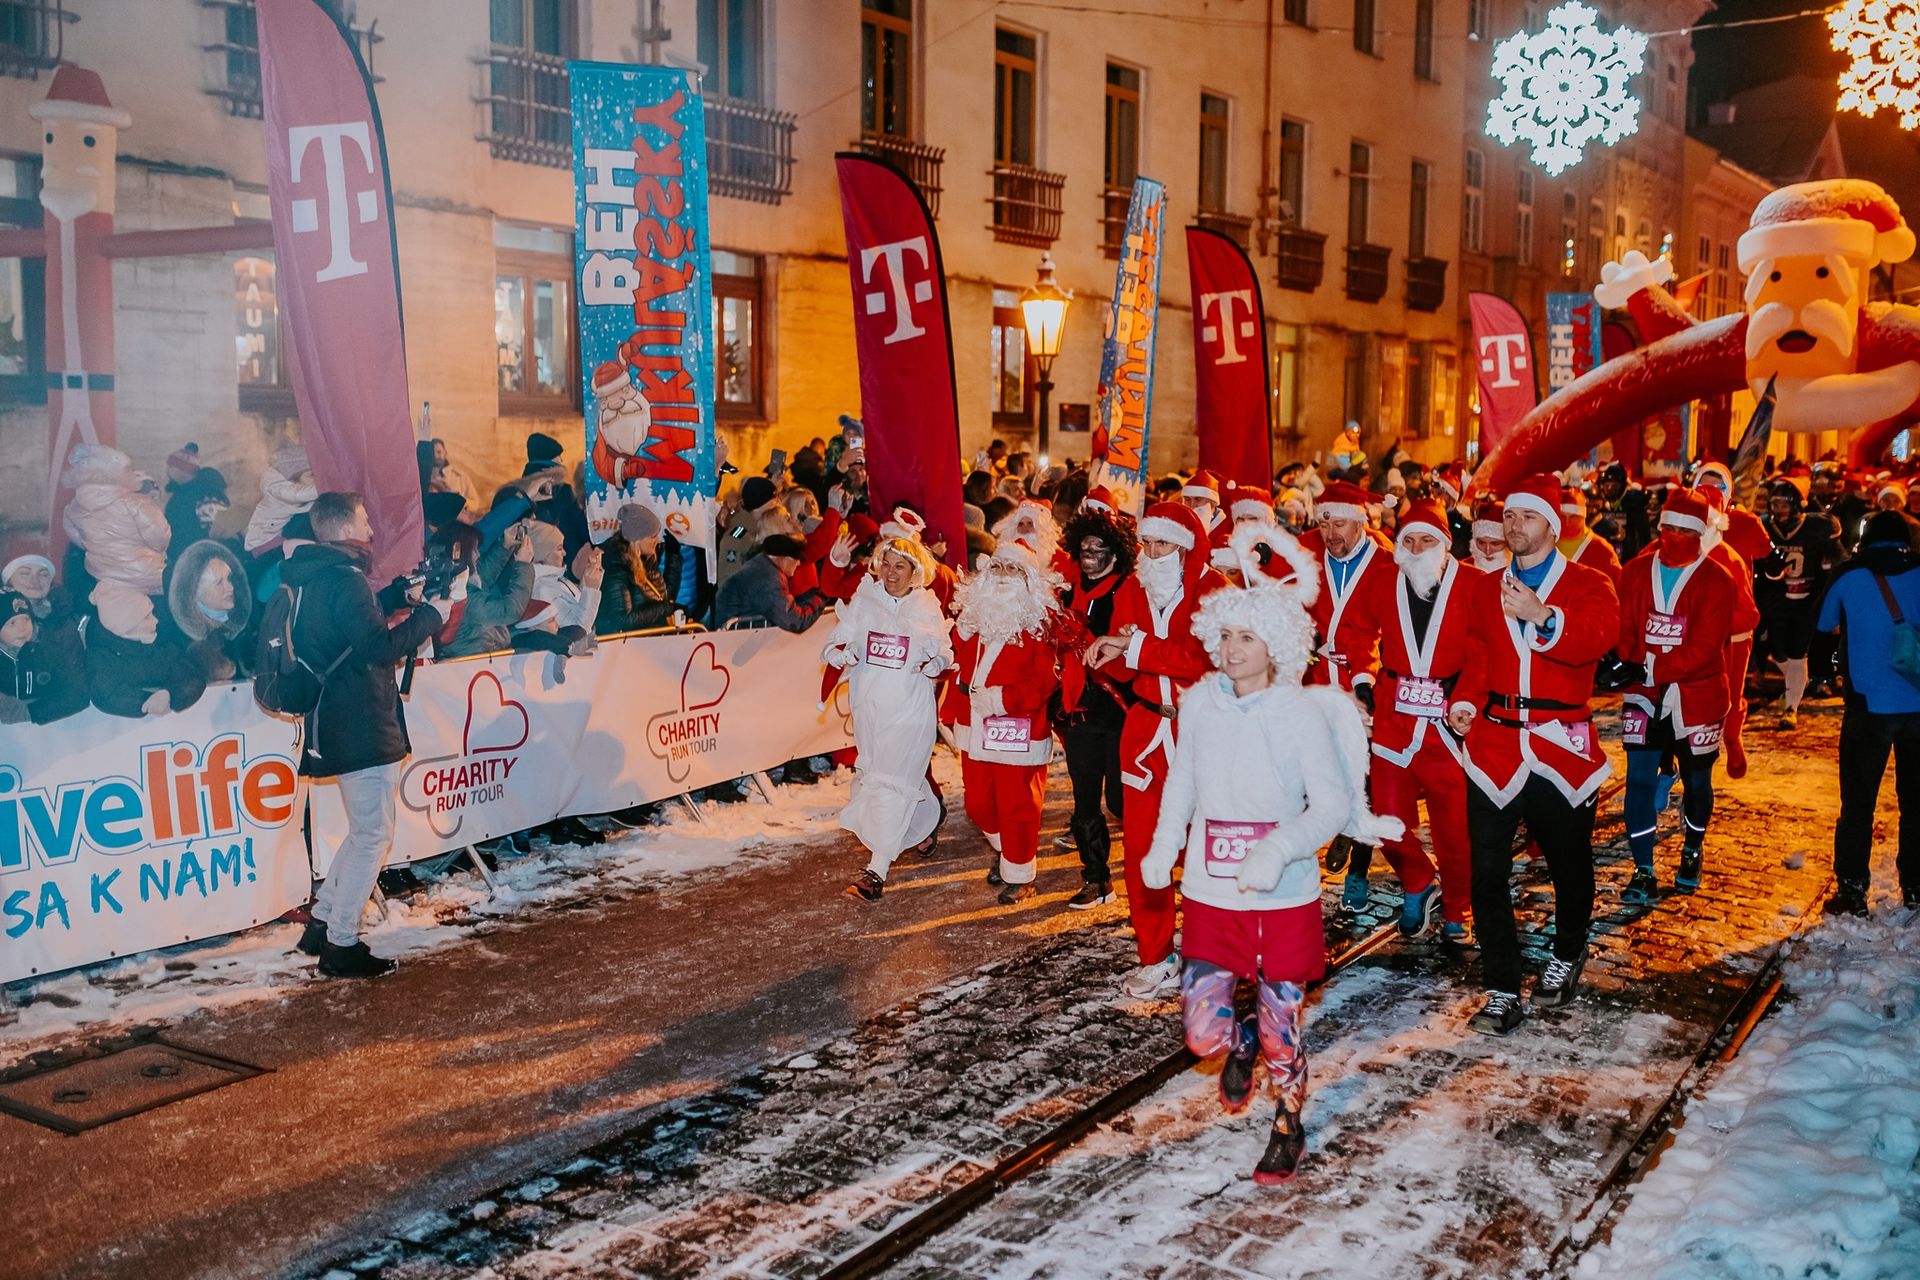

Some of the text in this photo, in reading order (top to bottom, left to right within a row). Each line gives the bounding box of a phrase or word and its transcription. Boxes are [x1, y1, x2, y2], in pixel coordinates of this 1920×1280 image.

[289, 121, 378, 283] T
[861, 235, 933, 345] T
[1200, 289, 1255, 365] T
[1480, 333, 1527, 388] T
[1646, 619, 1683, 636] 0742
[870, 642, 906, 658] 0750
[659, 712, 720, 746] CHARITY
[987, 727, 1028, 741] 0734
[1623, 719, 1642, 732] 51
[1693, 730, 1721, 745] 075
[671, 737, 717, 761] RUN TOUR
[423, 756, 519, 796] CHARITY
[436, 784, 505, 812] RUN TOUR
[3, 838, 256, 938] SA K NÁM!
